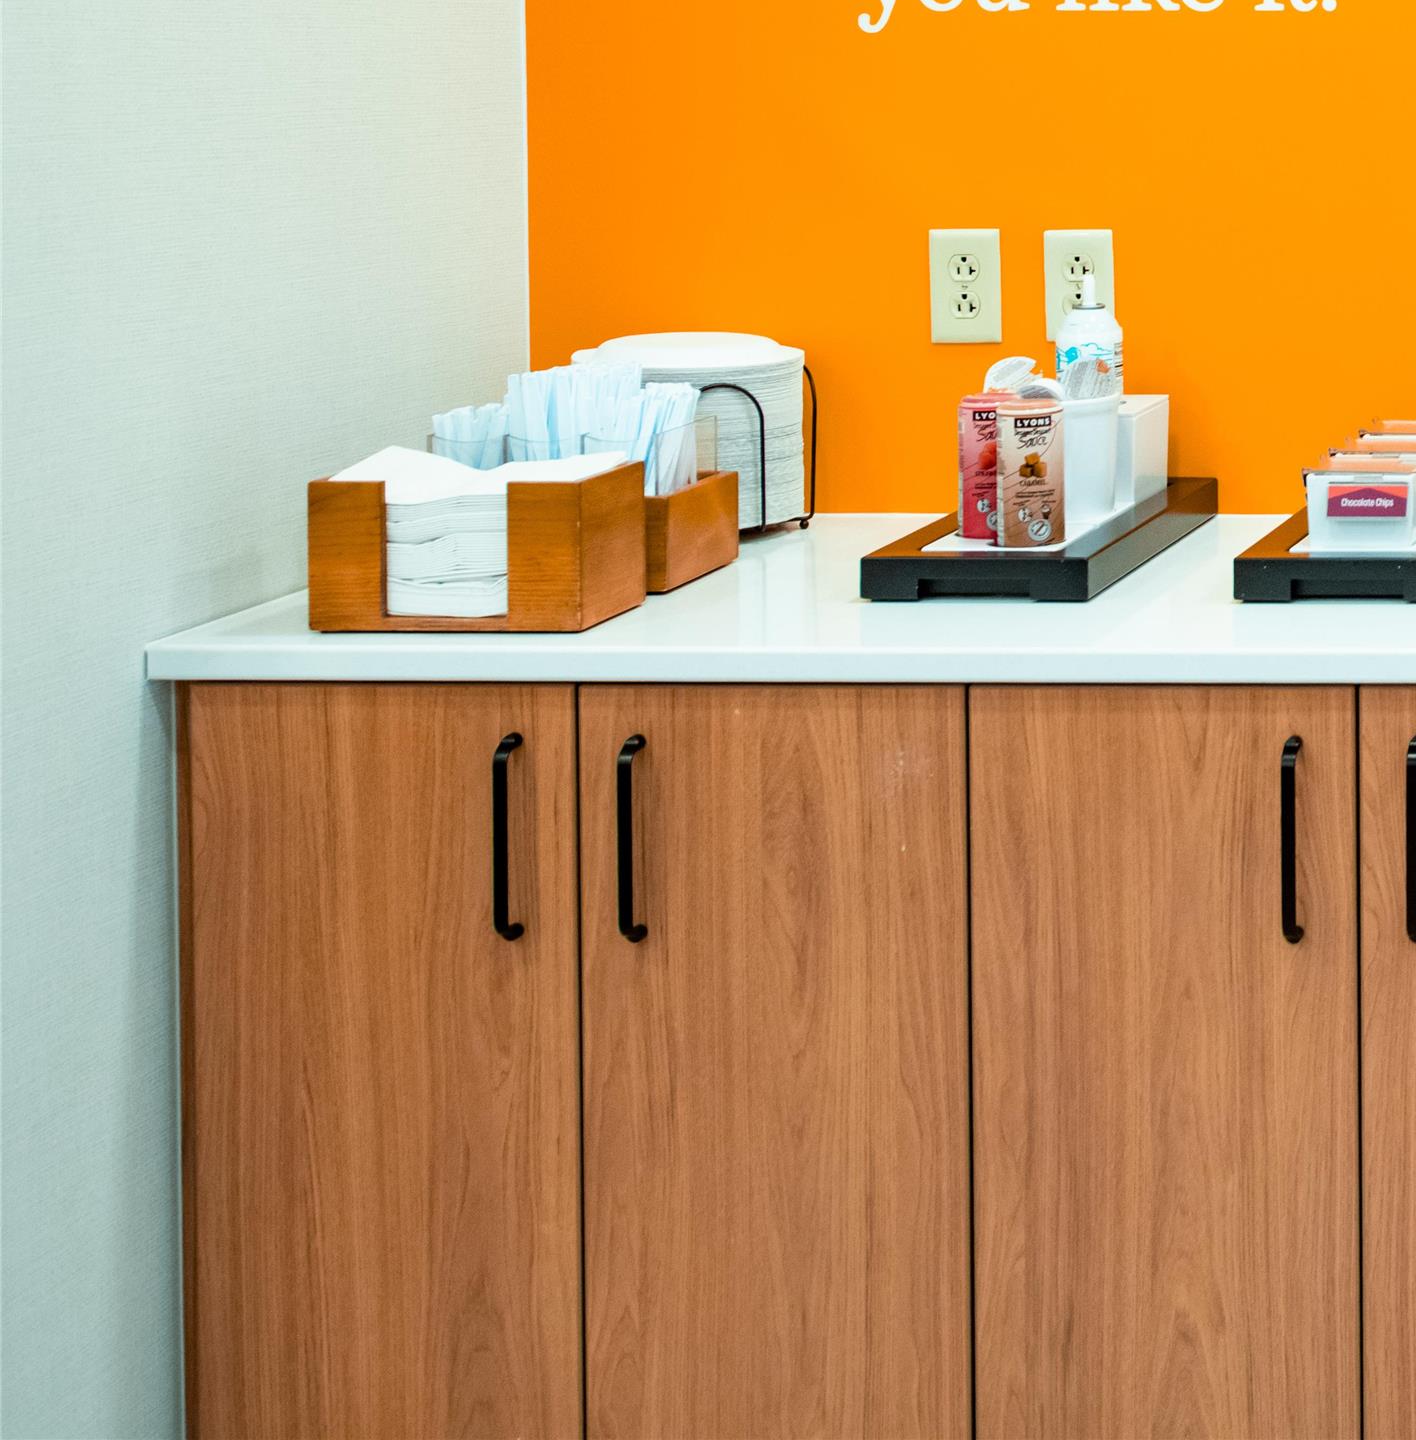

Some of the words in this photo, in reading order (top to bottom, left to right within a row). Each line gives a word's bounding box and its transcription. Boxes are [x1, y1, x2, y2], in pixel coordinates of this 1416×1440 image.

[974, 412, 996, 420] LYO
[1016, 417, 1050, 427] LYONS
[1340, 497, 1375, 508] Chocolate
[1375, 497, 1394, 509] Chips
